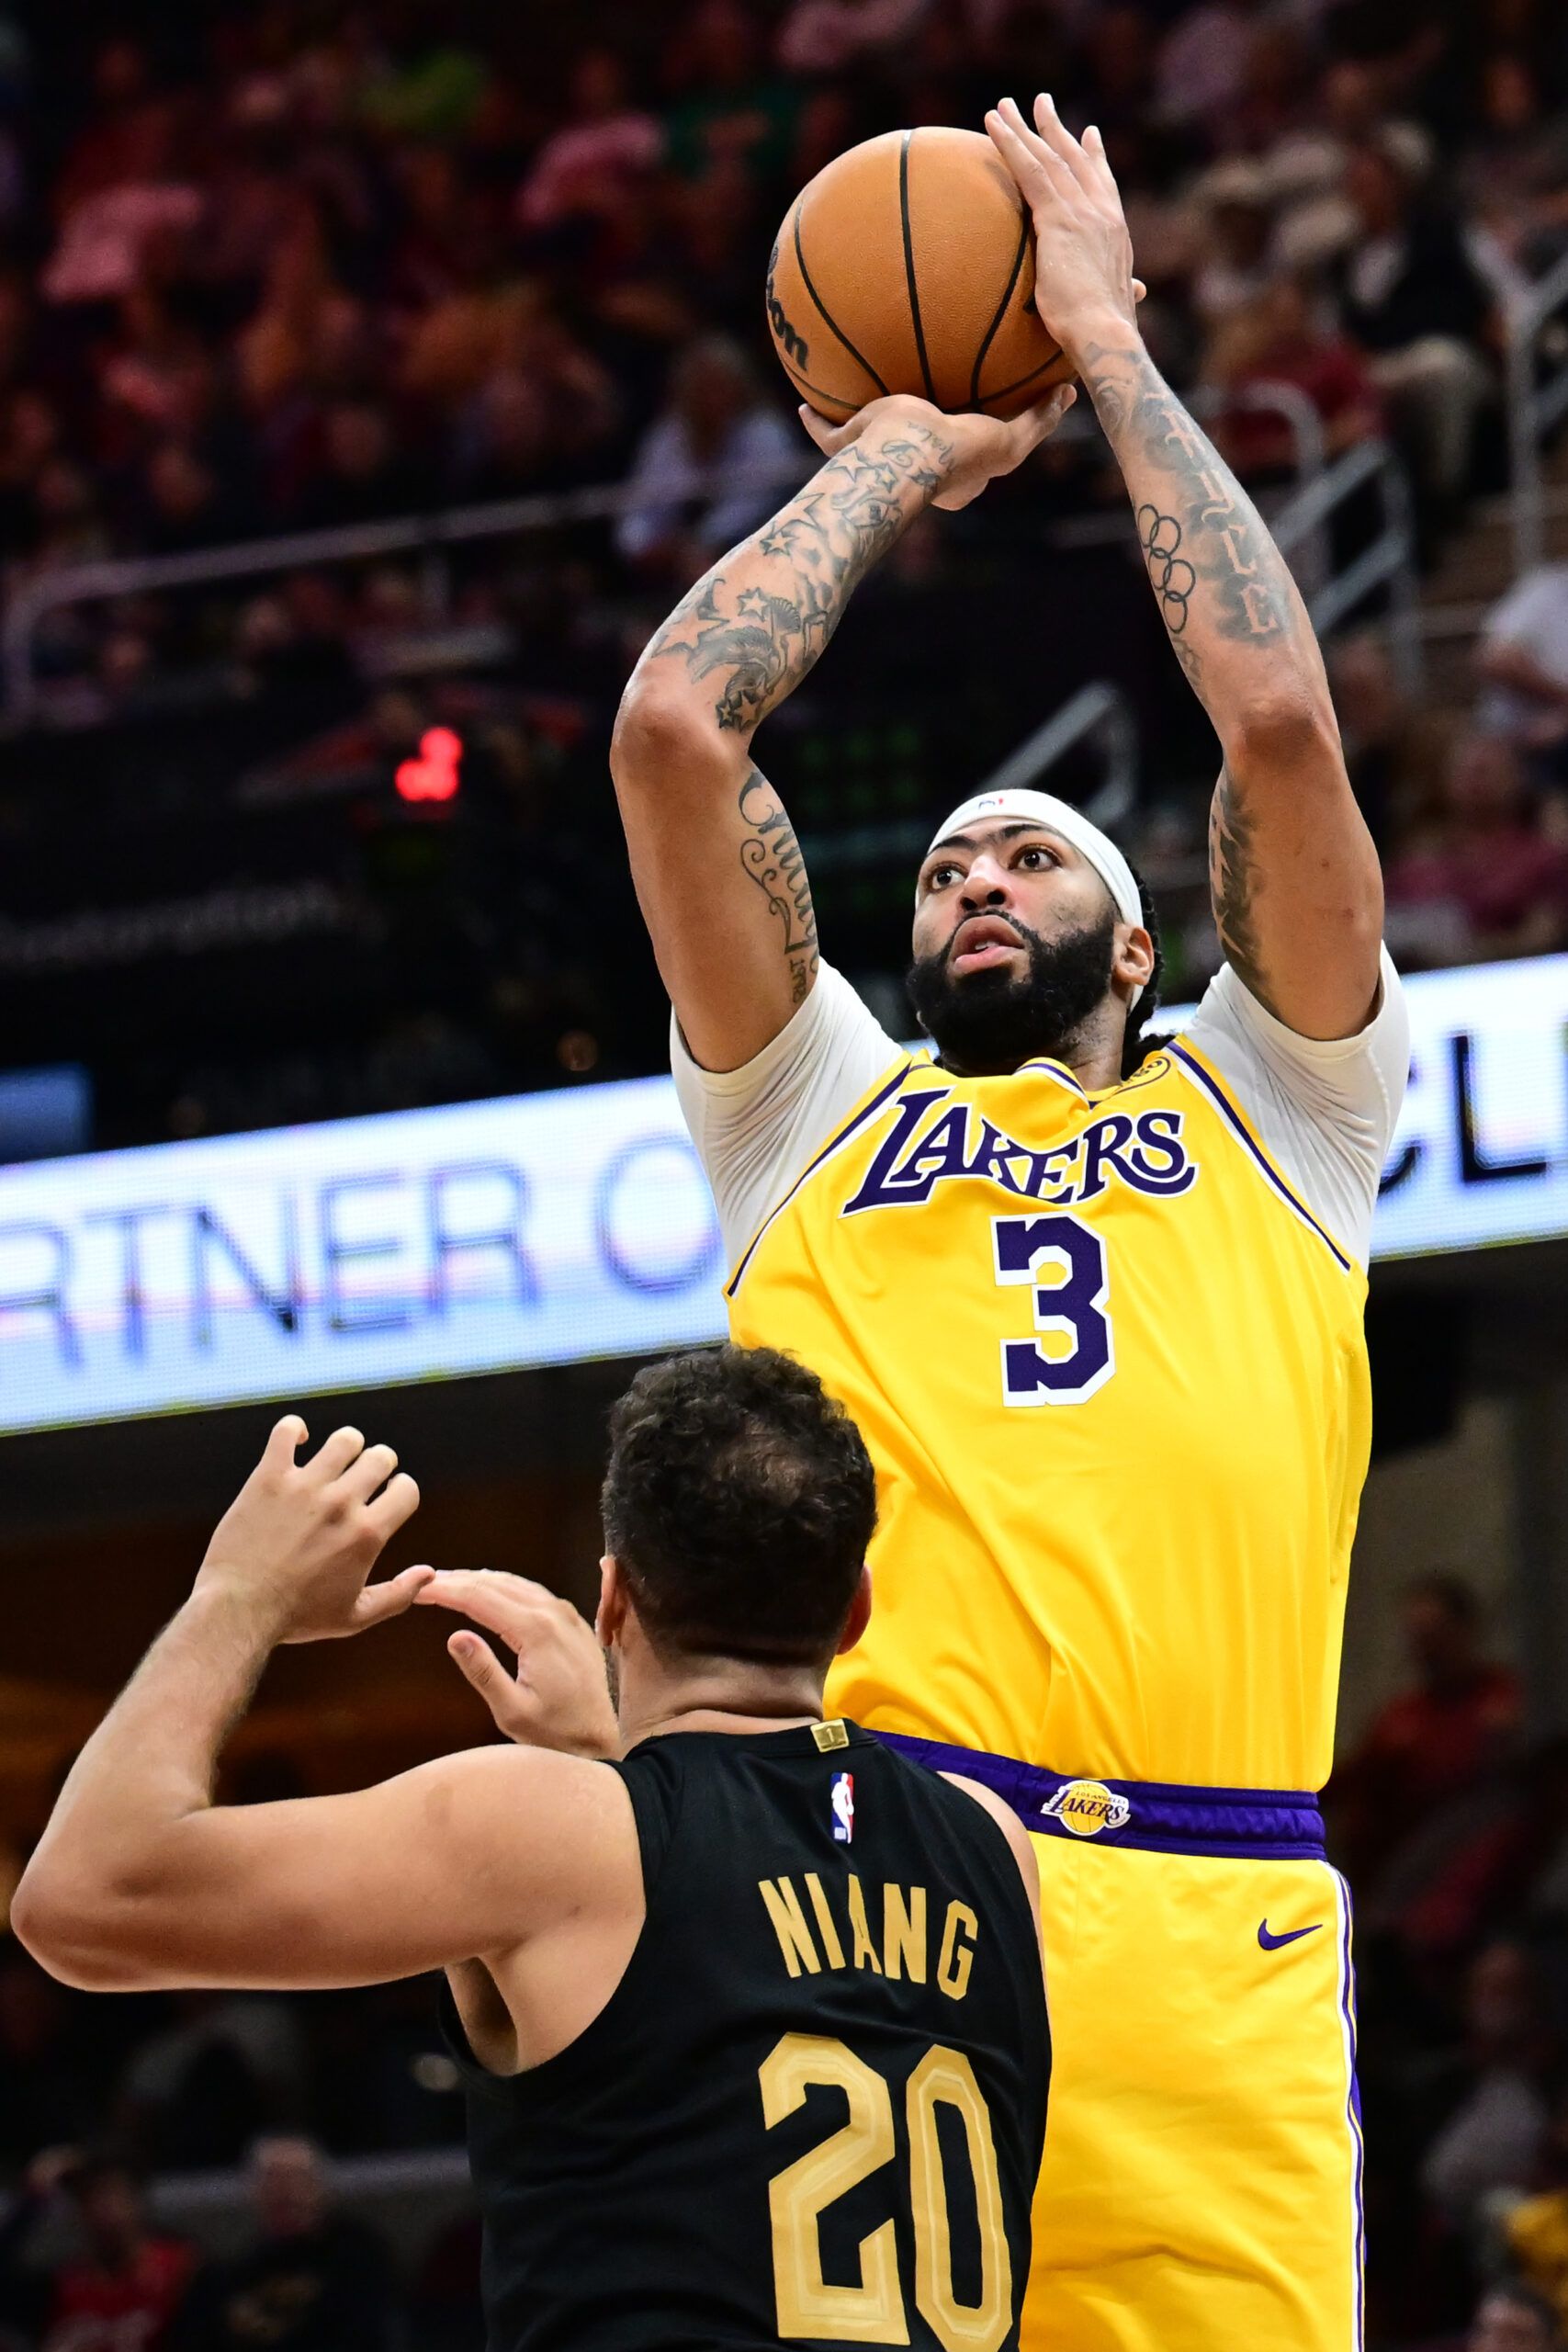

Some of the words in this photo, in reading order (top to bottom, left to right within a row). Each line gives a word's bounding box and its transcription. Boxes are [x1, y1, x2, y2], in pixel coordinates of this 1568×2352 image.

[840, 1086, 1197, 1217] LAKERS
[990, 1211, 1116, 1407] 3
[1043, 1788, 1127, 1826] LAKERS
[758, 1872, 979, 2001] NIANG
[758, 2031, 1013, 2352] 20
